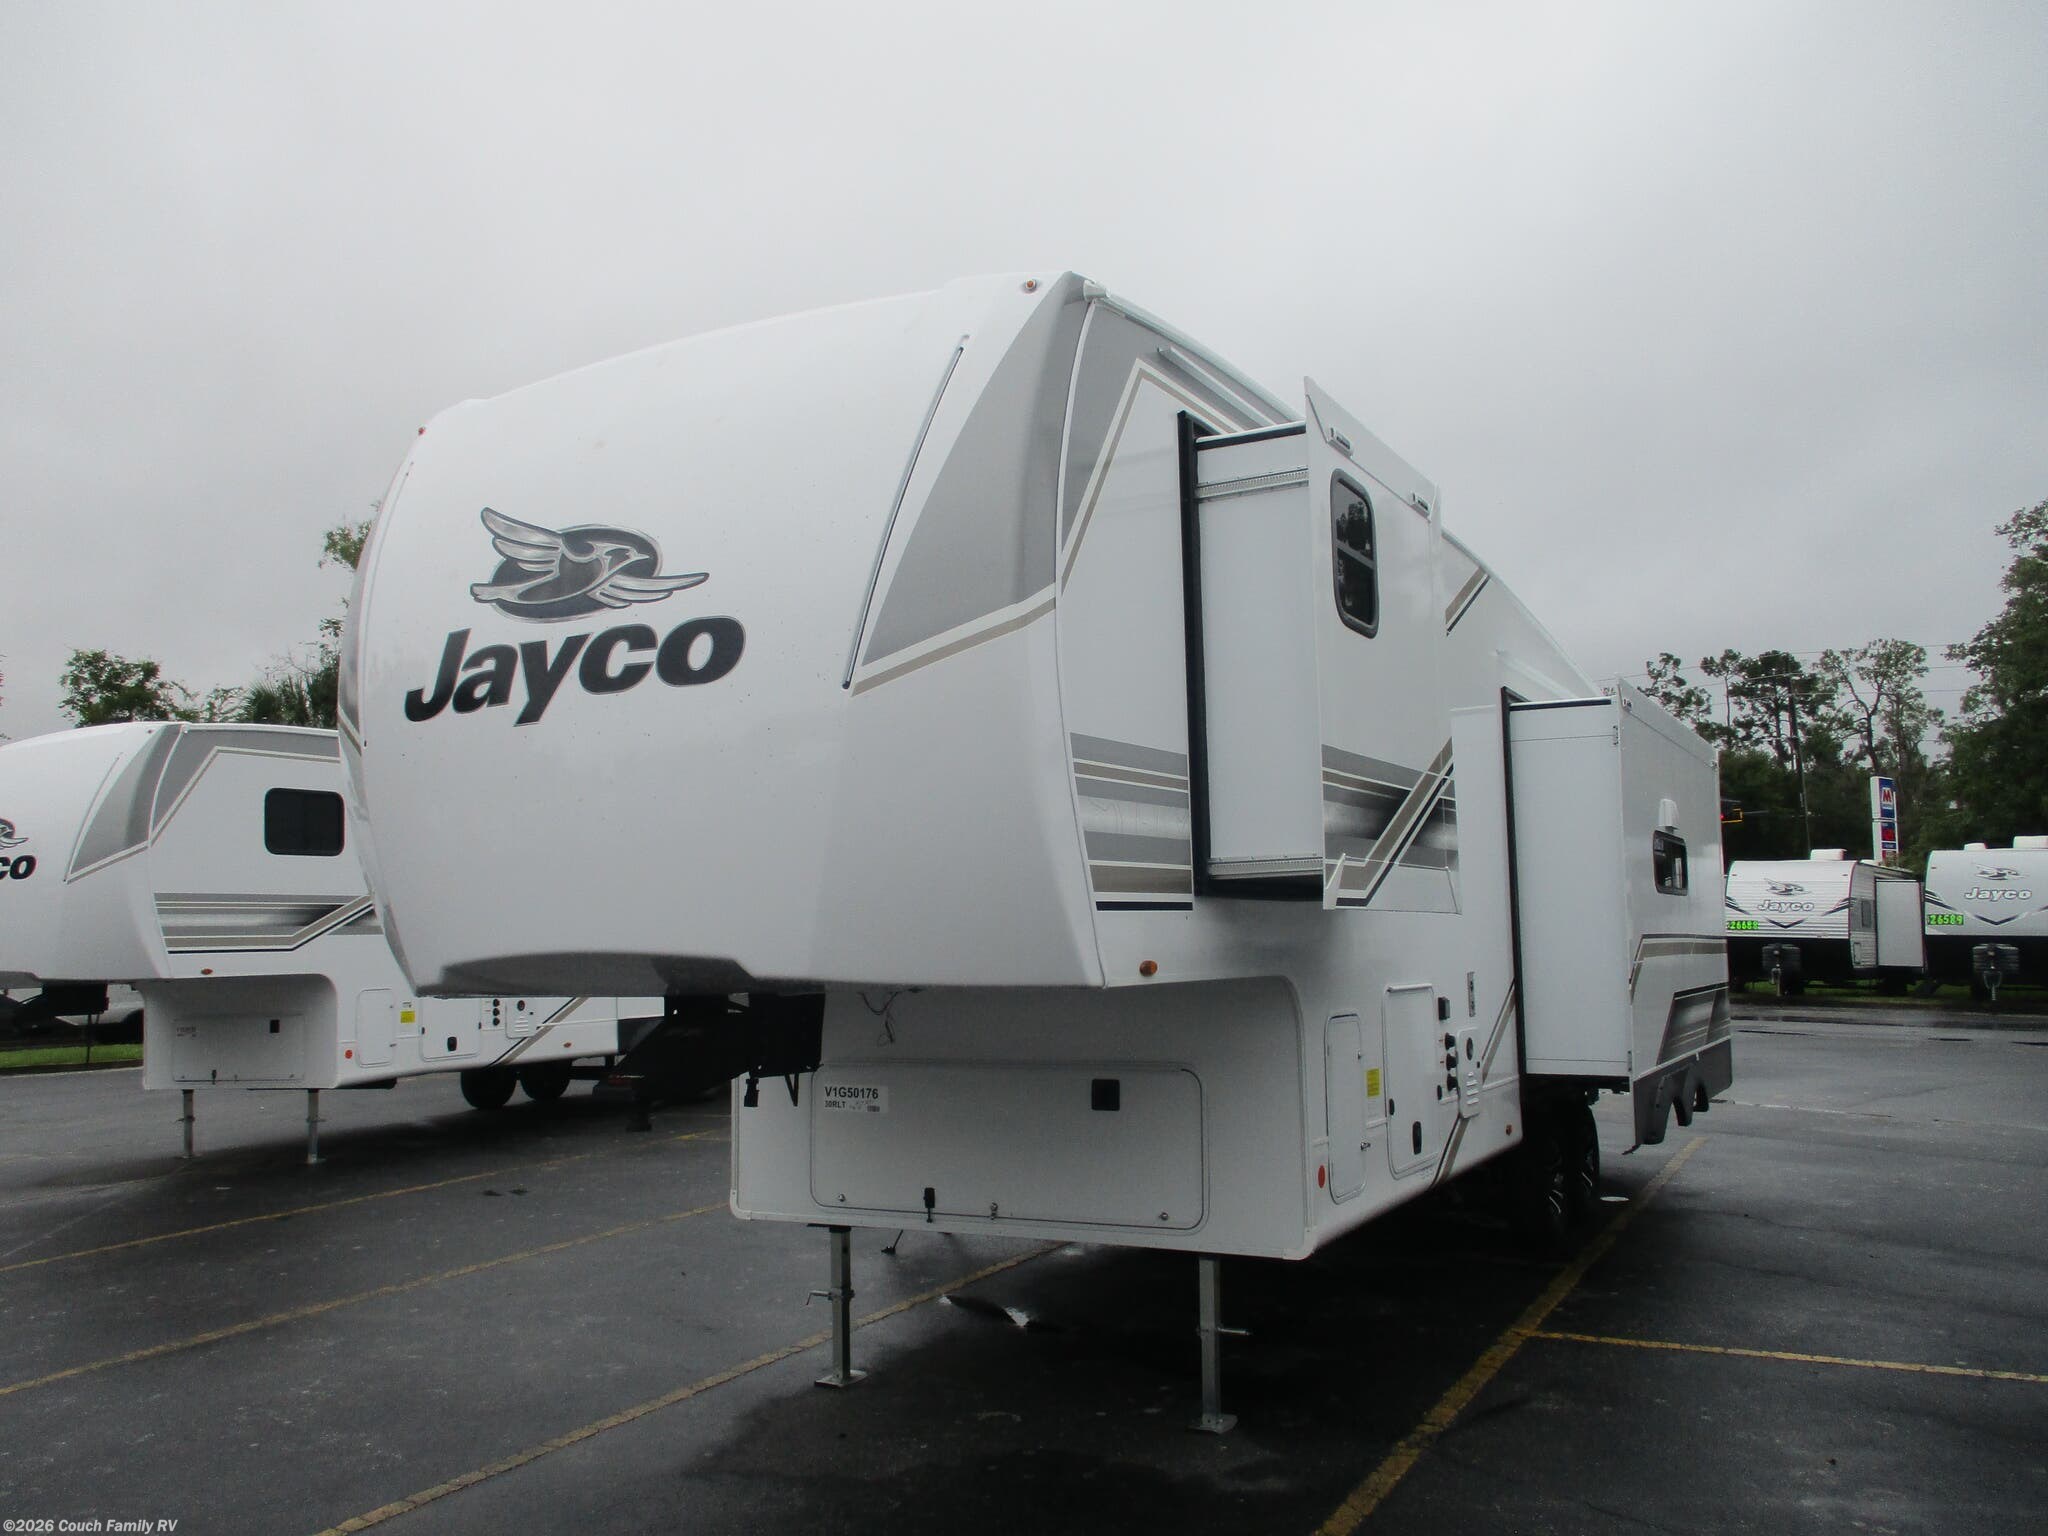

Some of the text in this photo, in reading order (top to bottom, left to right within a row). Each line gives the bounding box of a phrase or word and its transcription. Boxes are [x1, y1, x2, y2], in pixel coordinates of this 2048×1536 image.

[404, 615, 746, 727] Jayco
[1964, 886, 2032, 902] Jayco
[1757, 900, 1815, 914] Jayco
[824, 1086, 879, 1099] V1G50176
